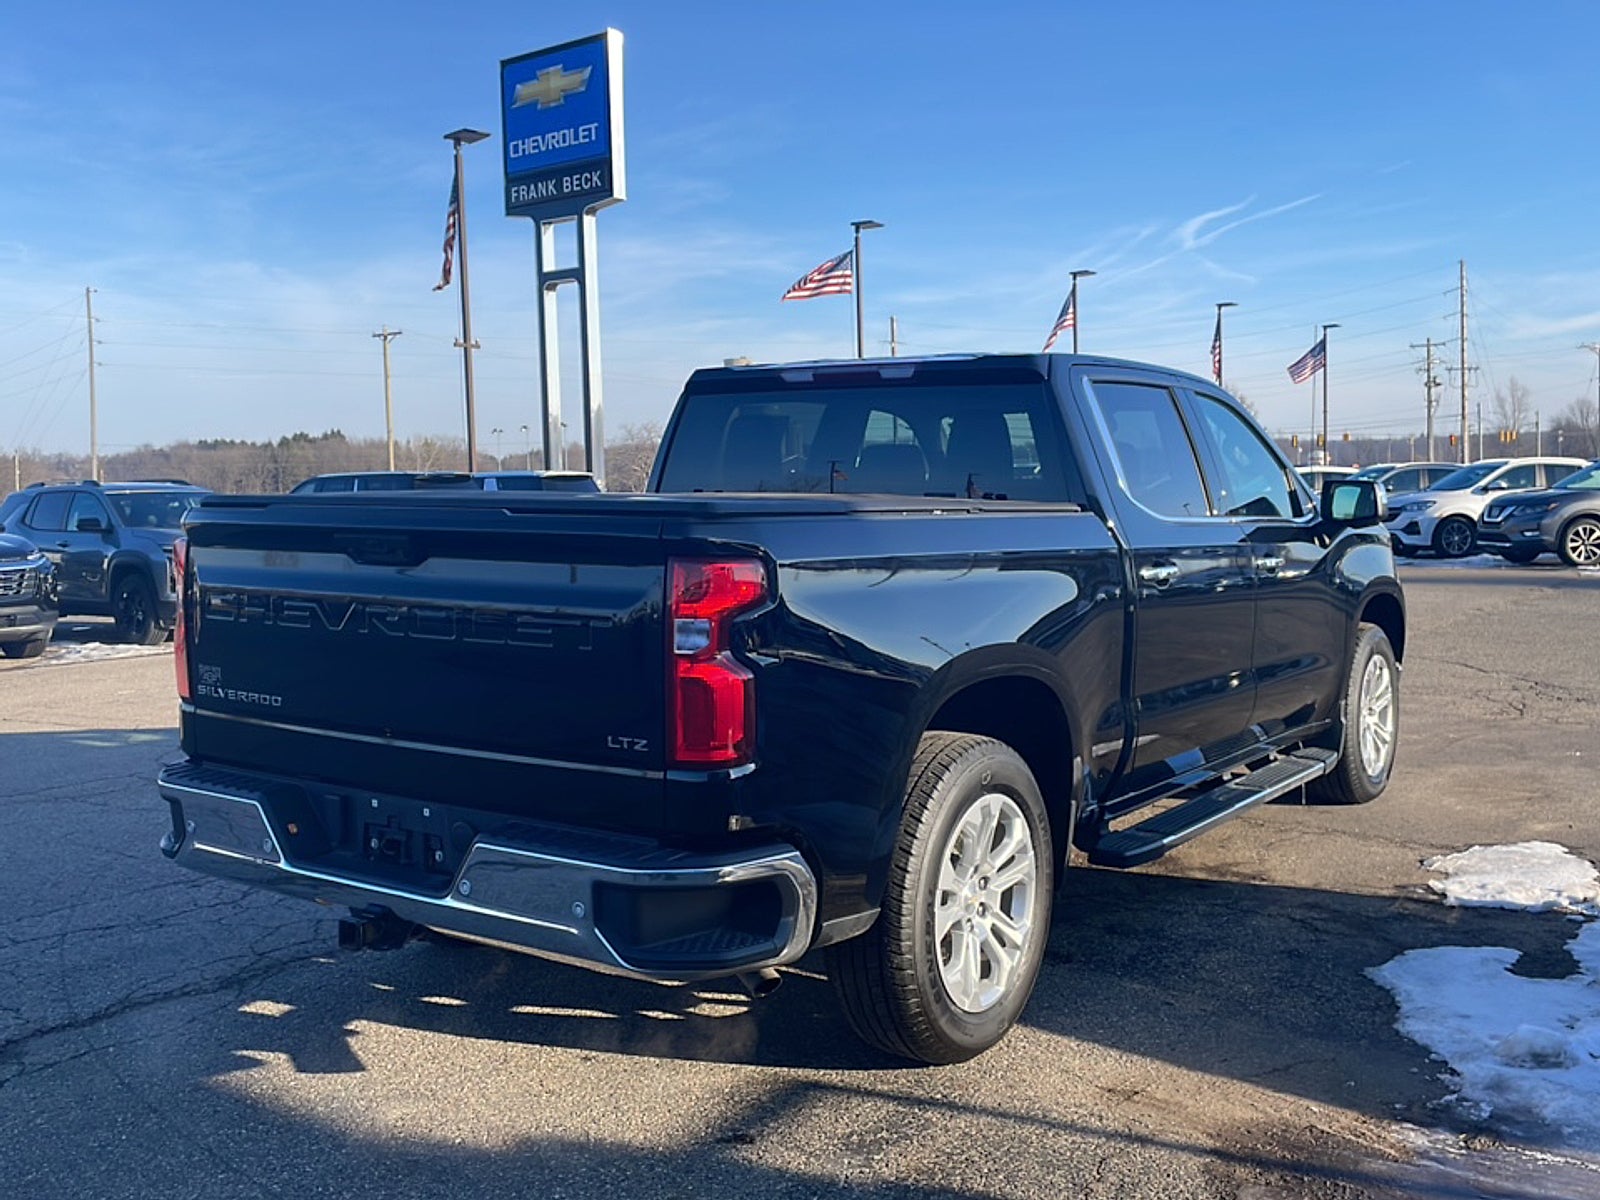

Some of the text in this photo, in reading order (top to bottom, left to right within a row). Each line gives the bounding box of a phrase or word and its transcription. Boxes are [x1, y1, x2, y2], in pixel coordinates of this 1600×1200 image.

[509, 123, 599, 158] CHEVROLET
[511, 170, 602, 202] FRANK BECK
[205, 592, 613, 650] CHEVROLET
[197, 684, 282, 707] SILVERADO
[607, 735, 649, 751] LTZ
